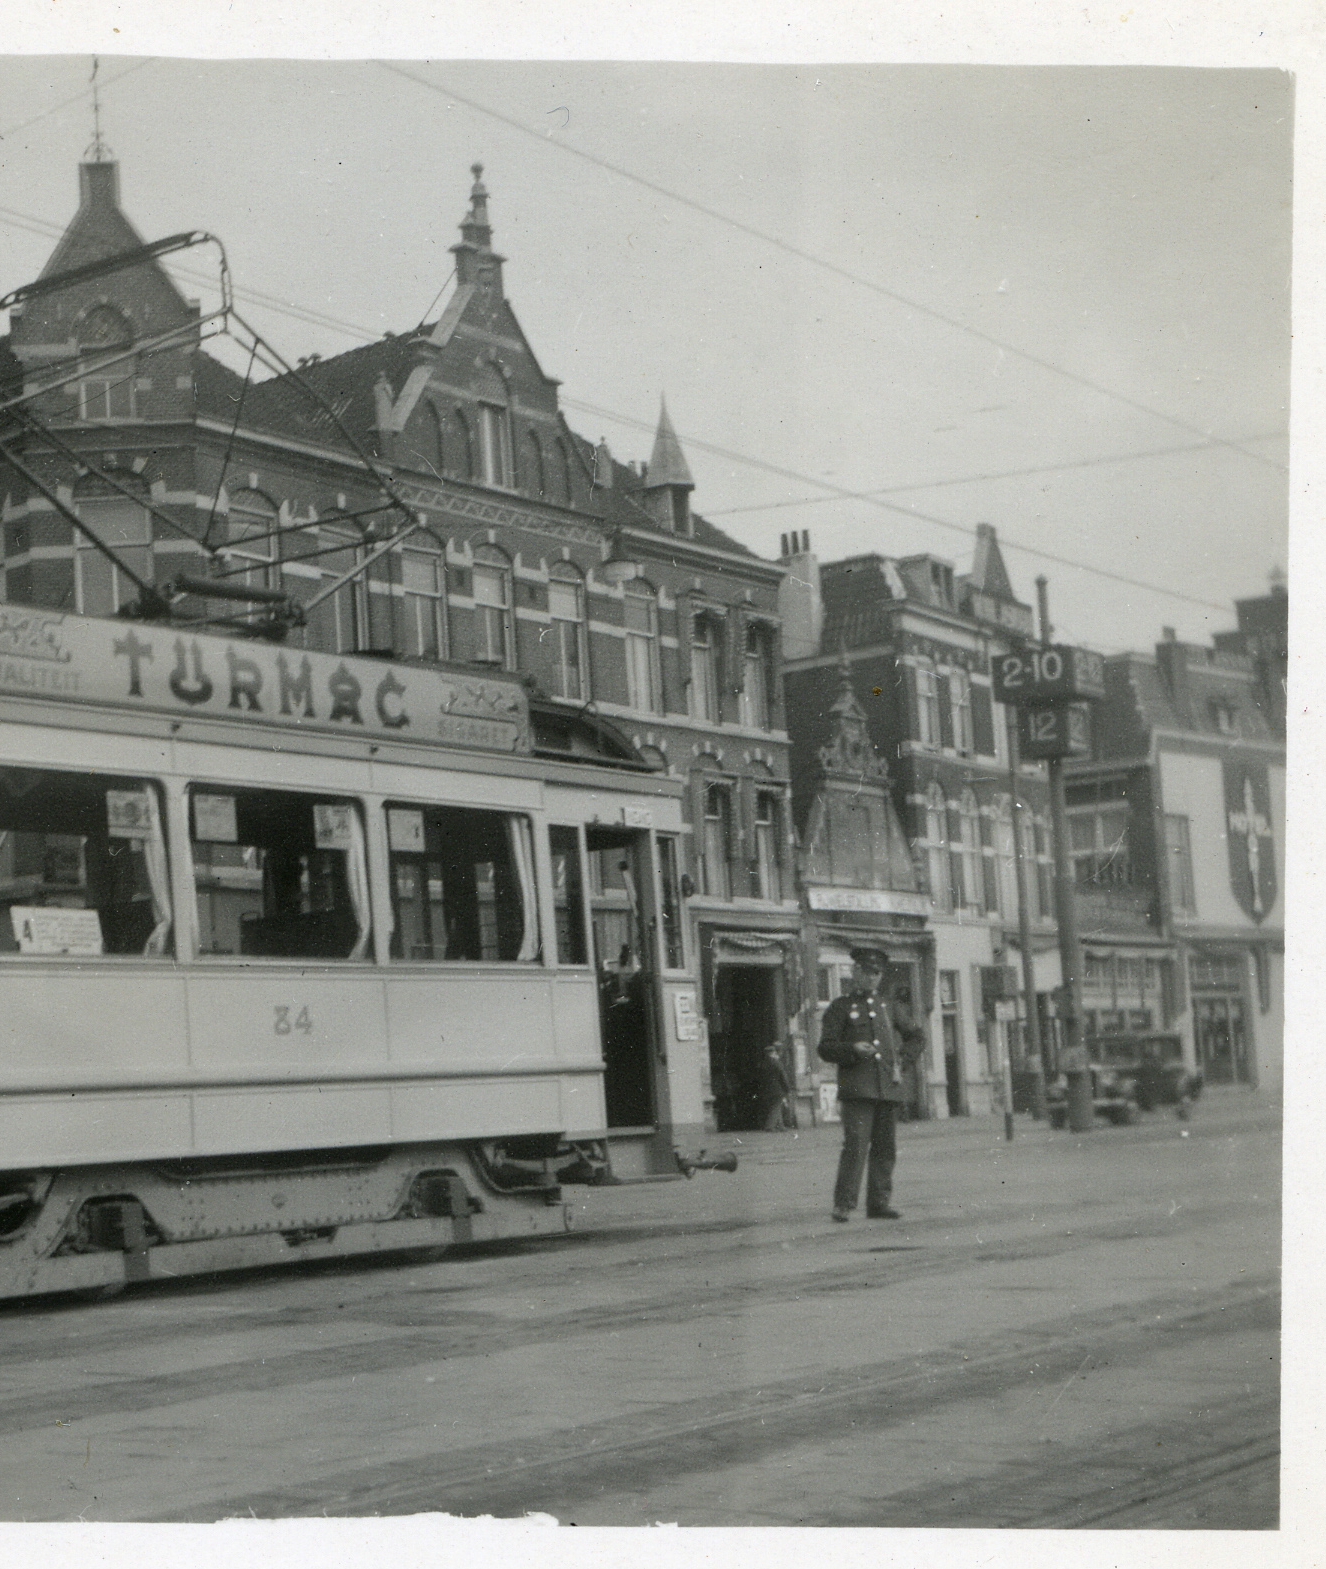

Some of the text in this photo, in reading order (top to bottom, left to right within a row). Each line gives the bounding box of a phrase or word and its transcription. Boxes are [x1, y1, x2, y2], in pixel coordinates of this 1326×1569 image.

[112, 628, 411, 729] TURMAC
[1028, 711, 1057, 741] 12
[273, 1005, 313, 1036] 84
